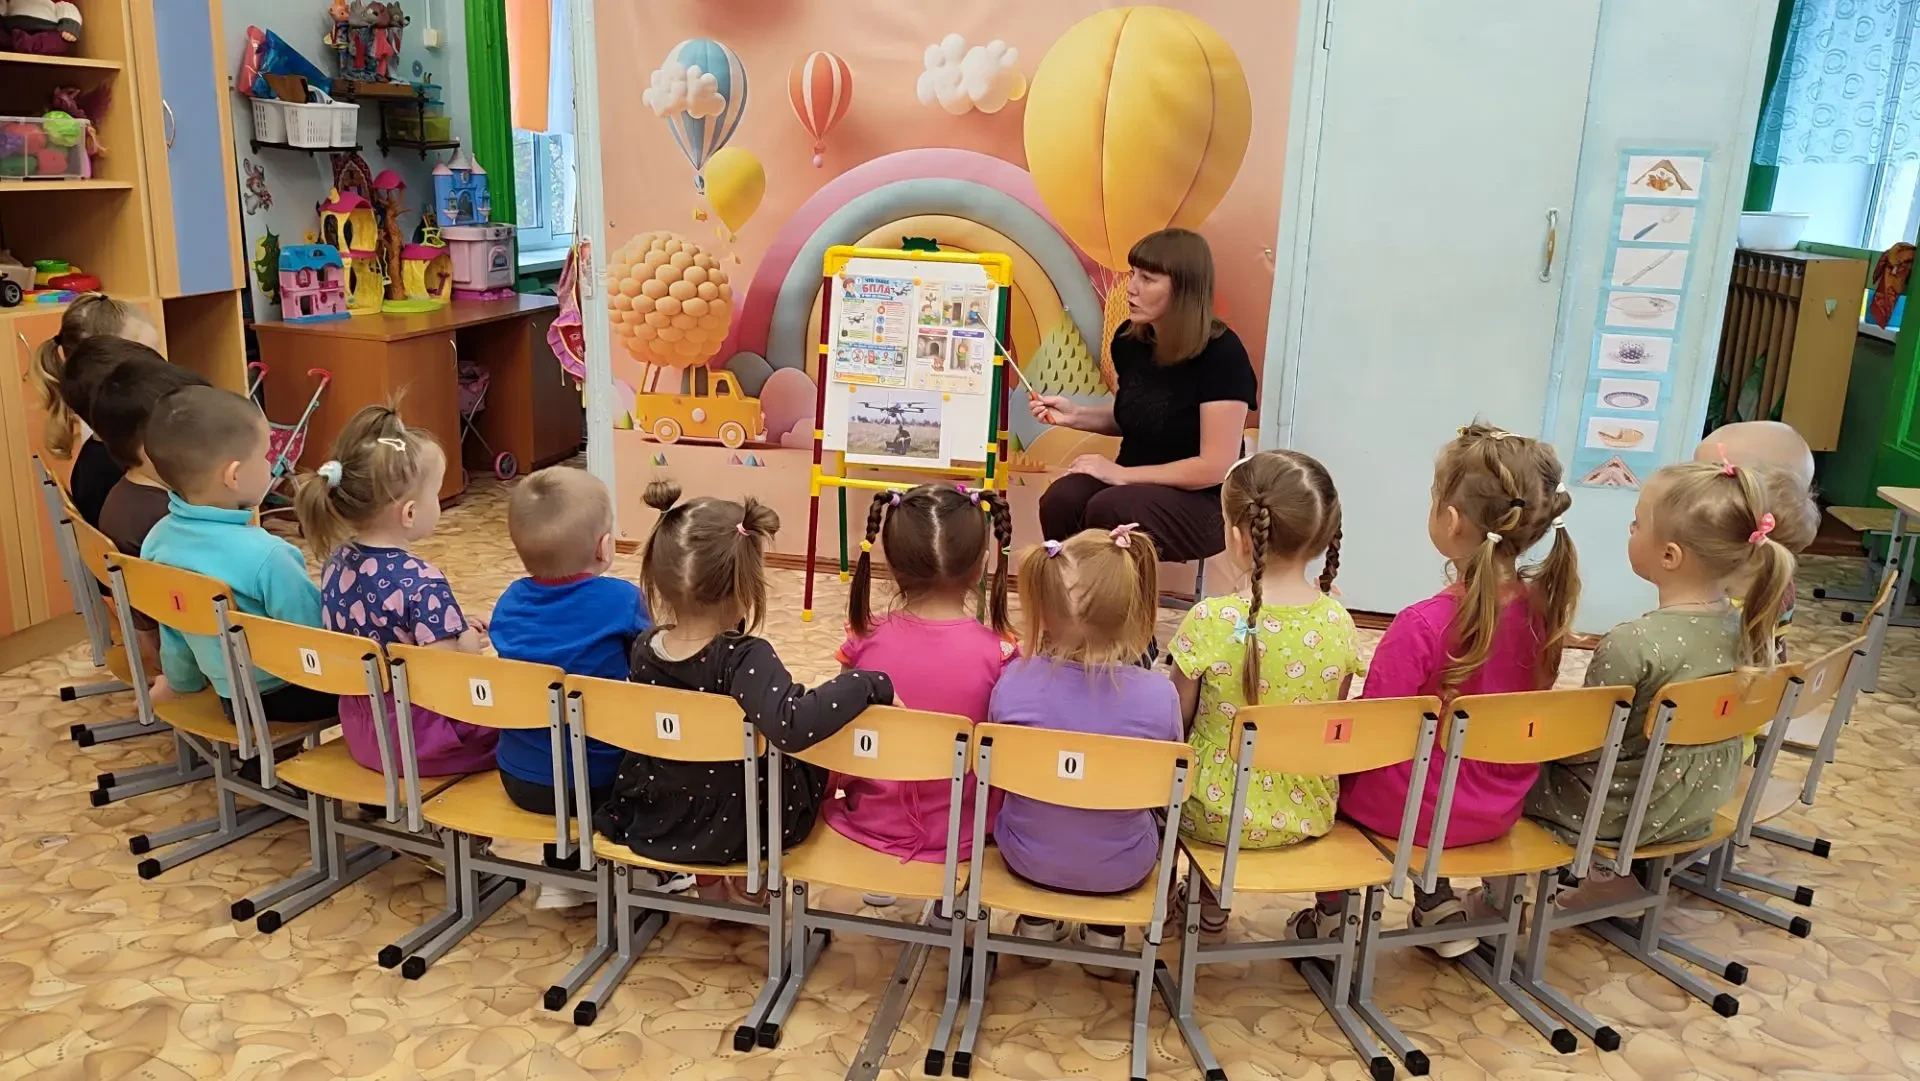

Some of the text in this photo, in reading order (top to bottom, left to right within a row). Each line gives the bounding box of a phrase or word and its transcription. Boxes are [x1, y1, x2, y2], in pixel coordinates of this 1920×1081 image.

[862, 284, 890, 294] БПЛА
[174, 595, 181, 610] 1
[306, 653, 315, 669] 0
[476, 684, 486, 700] 0
[1721, 700, 1729, 716] 1
[662, 717, 674, 733] 0
[1334, 724, 1342, 740] 1
[1527, 722, 1534, 738] 1
[860, 735, 872, 751] 0
[1065, 757, 1076, 774] 0
